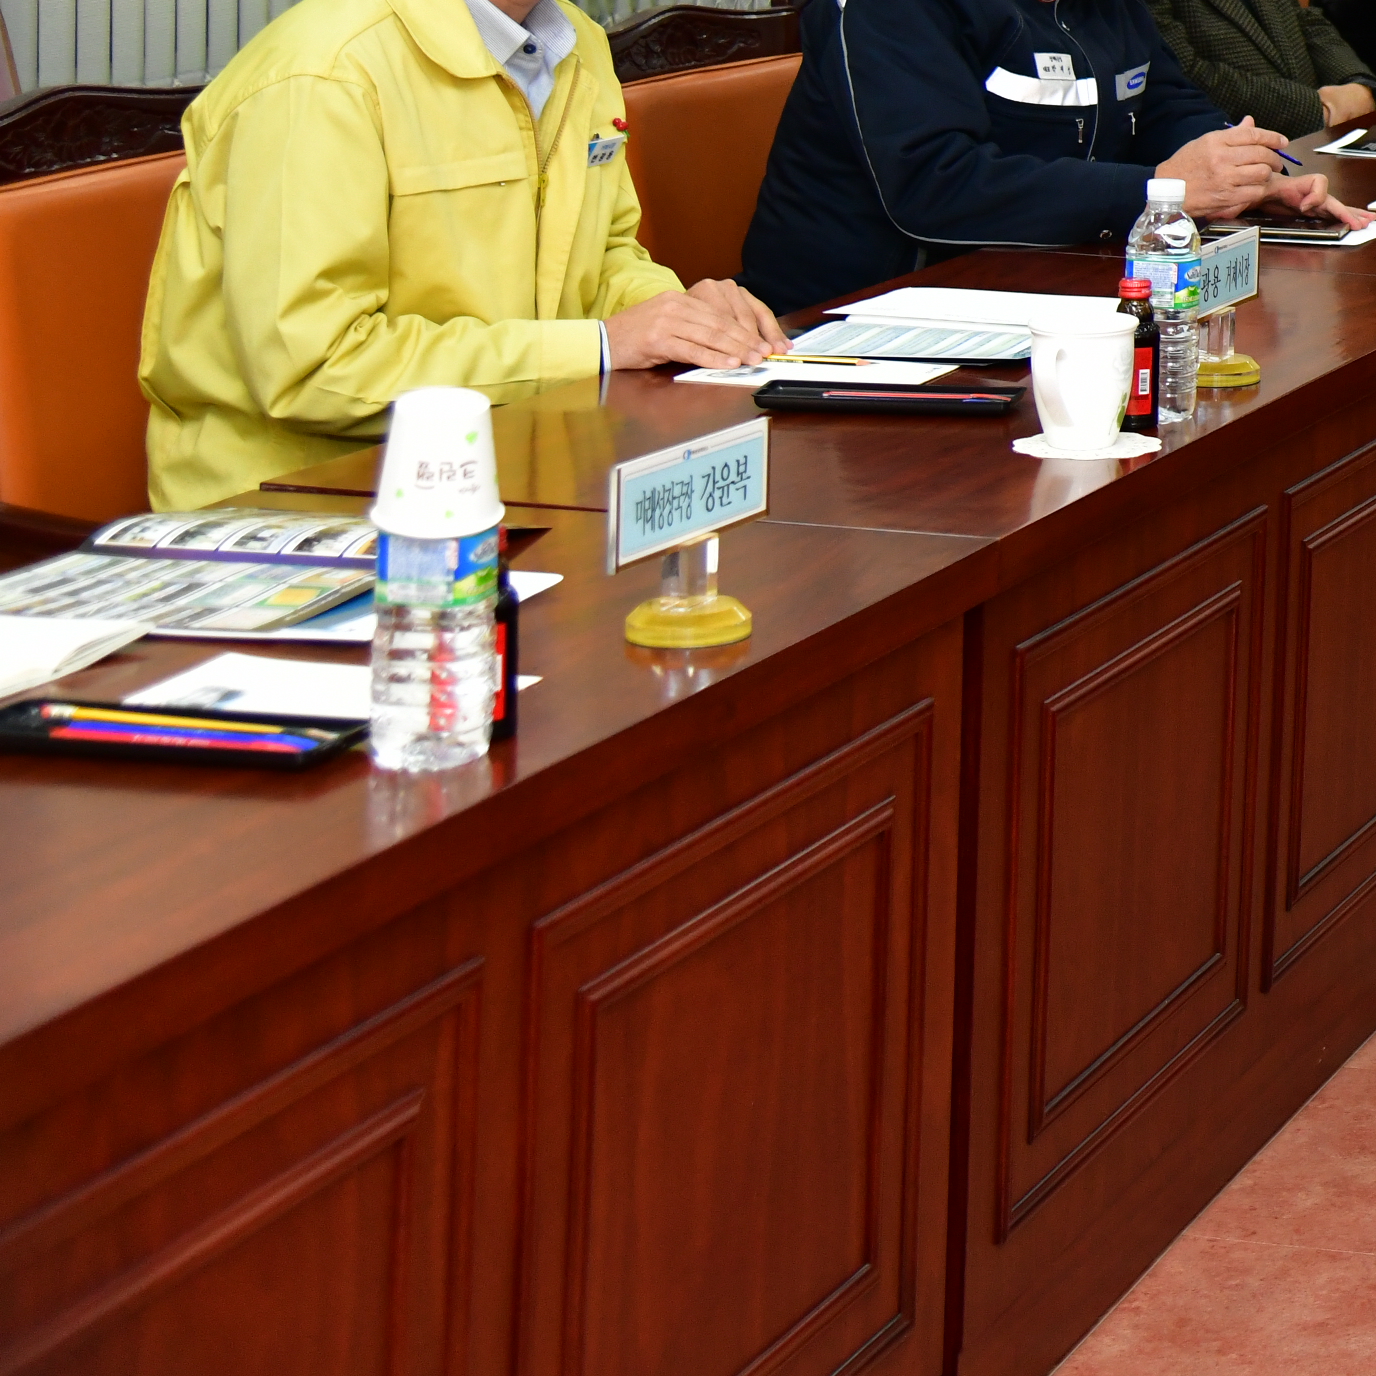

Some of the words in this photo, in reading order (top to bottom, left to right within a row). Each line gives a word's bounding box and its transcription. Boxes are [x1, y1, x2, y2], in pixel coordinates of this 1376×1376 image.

[1200, 264, 1221, 302] 광용
[635, 475, 694, 536] 미래성장국장
[700, 455, 751, 513] 강윤복
